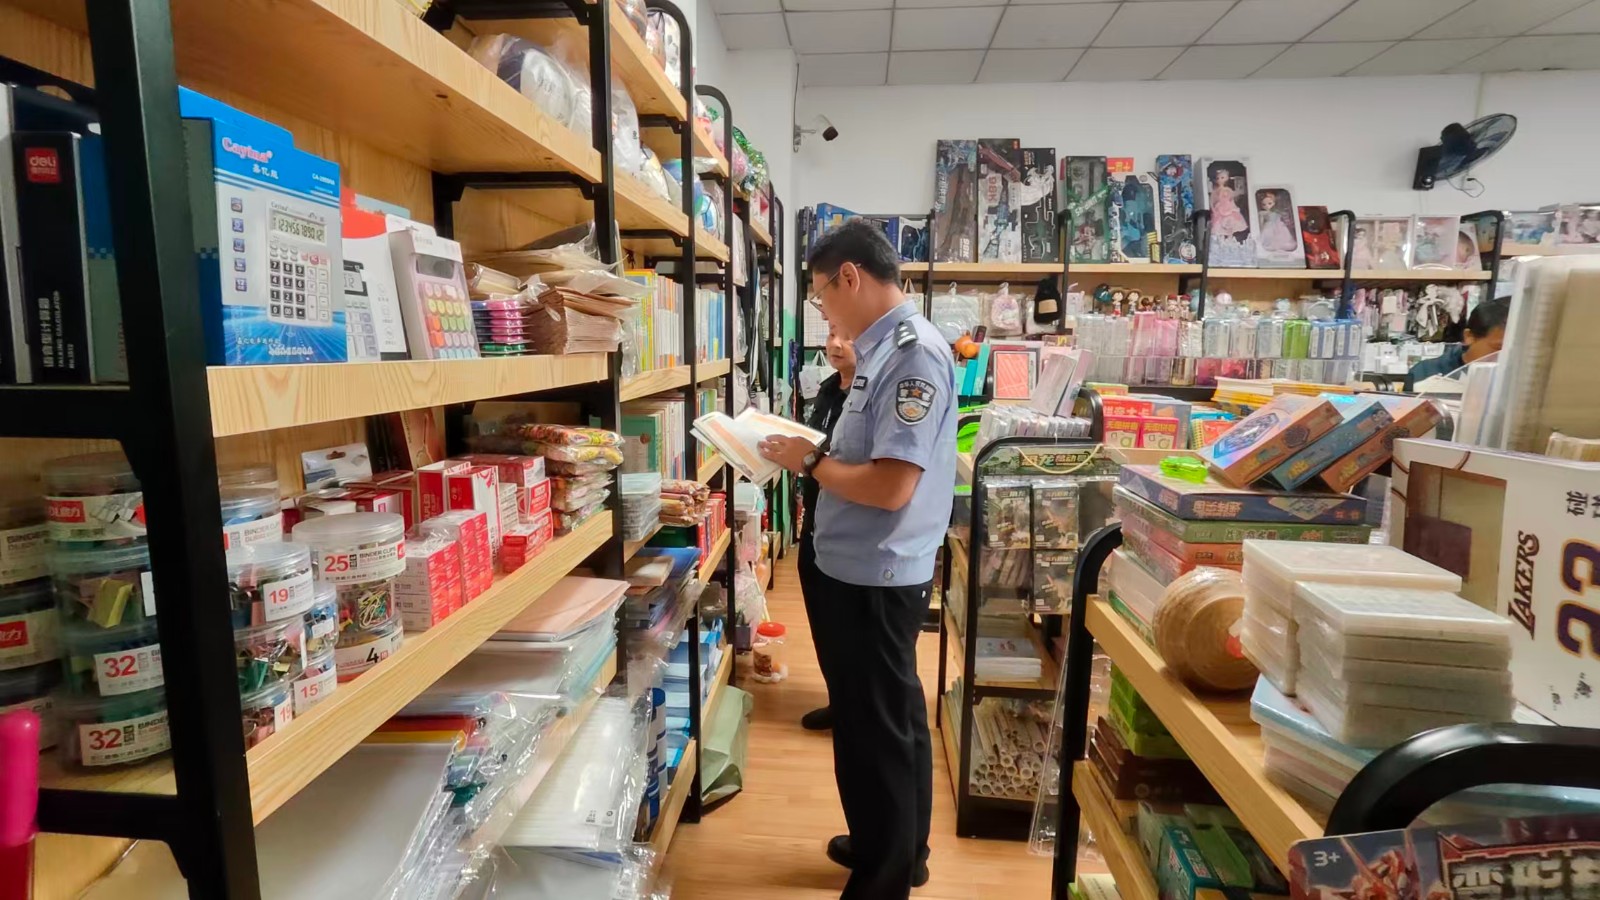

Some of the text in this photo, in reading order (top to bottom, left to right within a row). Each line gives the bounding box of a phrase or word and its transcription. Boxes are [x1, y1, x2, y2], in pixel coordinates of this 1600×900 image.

[30, 156, 56, 167] deli
[324, 555, 349, 572] 25
[359, 549, 382, 559] BINDER
[1508, 530, 1540, 641] LAKERS
[269, 588, 289, 605] 19
[366, 647, 380, 663] 4
[104, 655, 138, 678] 32
[301, 684, 318, 698] 15
[89, 715, 168, 750] 32 BINDE
[1313, 851, 1341, 867] 3+
